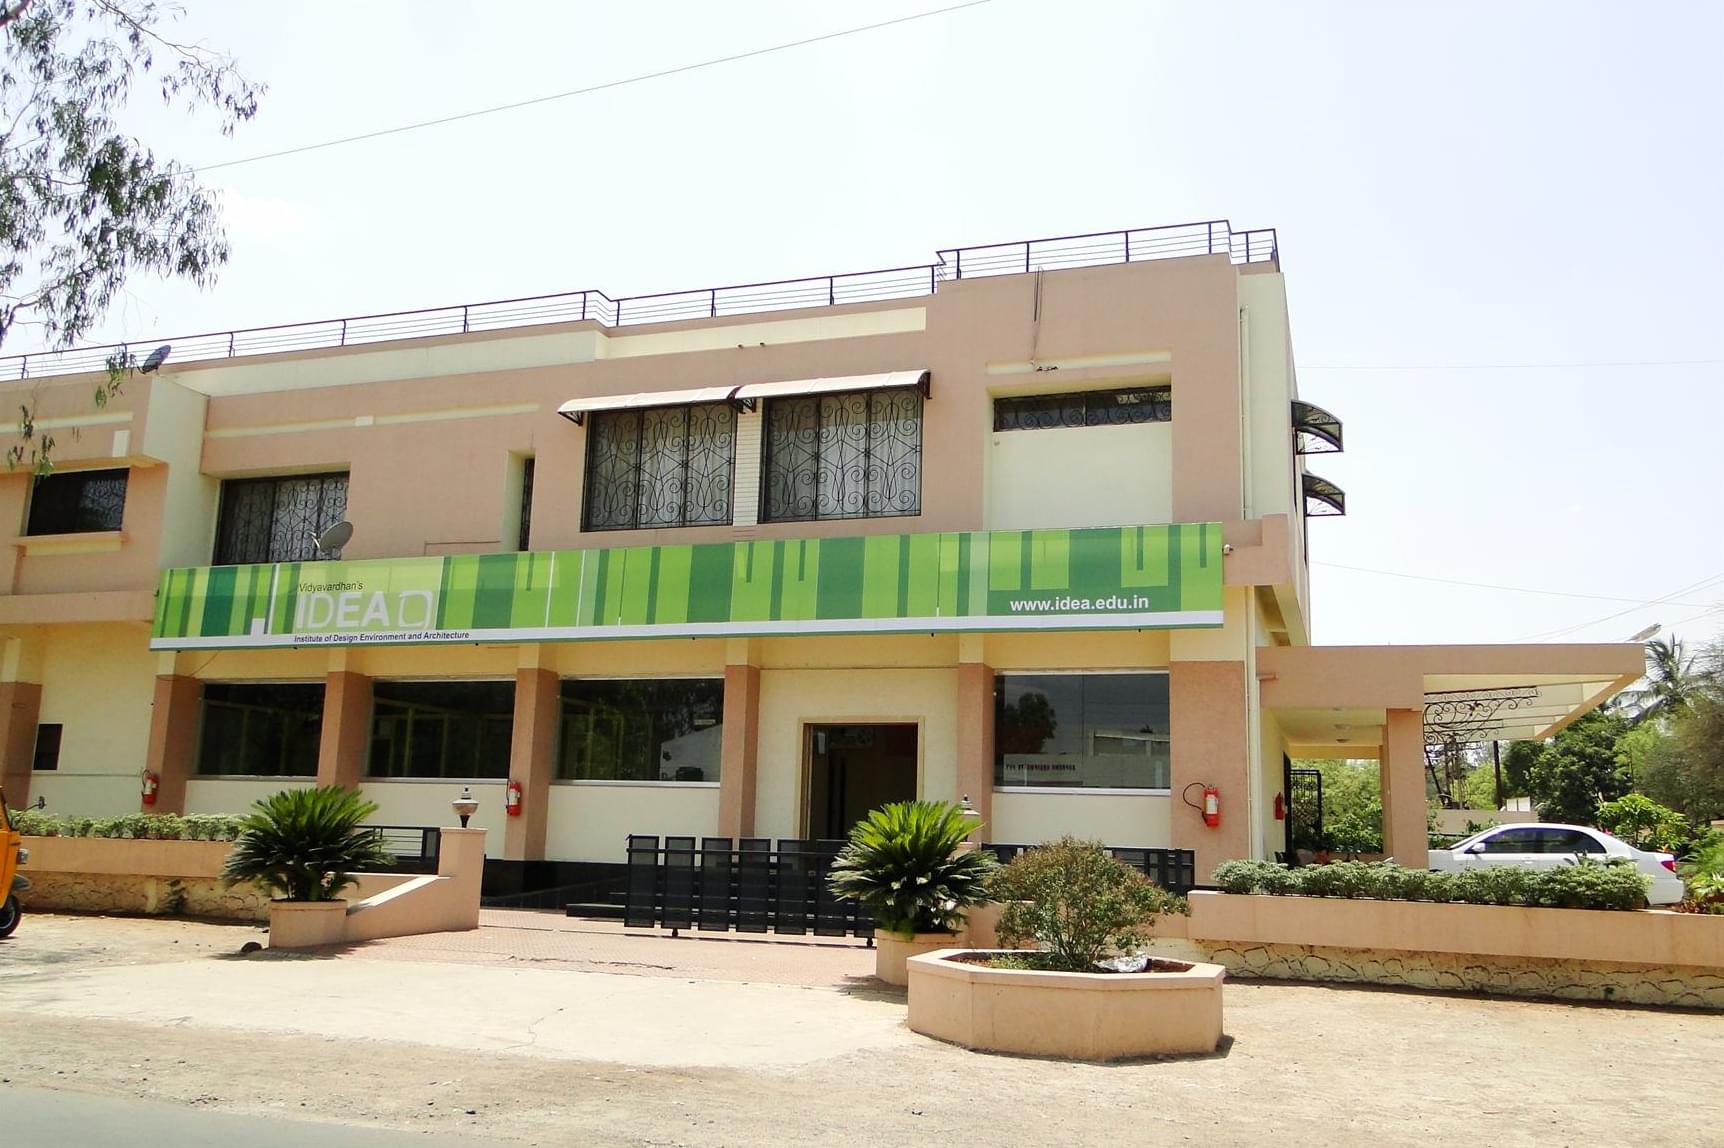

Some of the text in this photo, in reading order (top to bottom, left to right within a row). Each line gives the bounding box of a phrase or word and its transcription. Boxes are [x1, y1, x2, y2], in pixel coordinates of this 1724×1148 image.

[299, 581, 364, 594] Vidyavardhan's
[295, 591, 391, 629] IDEA
[1010, 594, 1149, 611] www.idea.edu.in
[294, 631, 470, 644] Institute of Design Environment and Architecture
